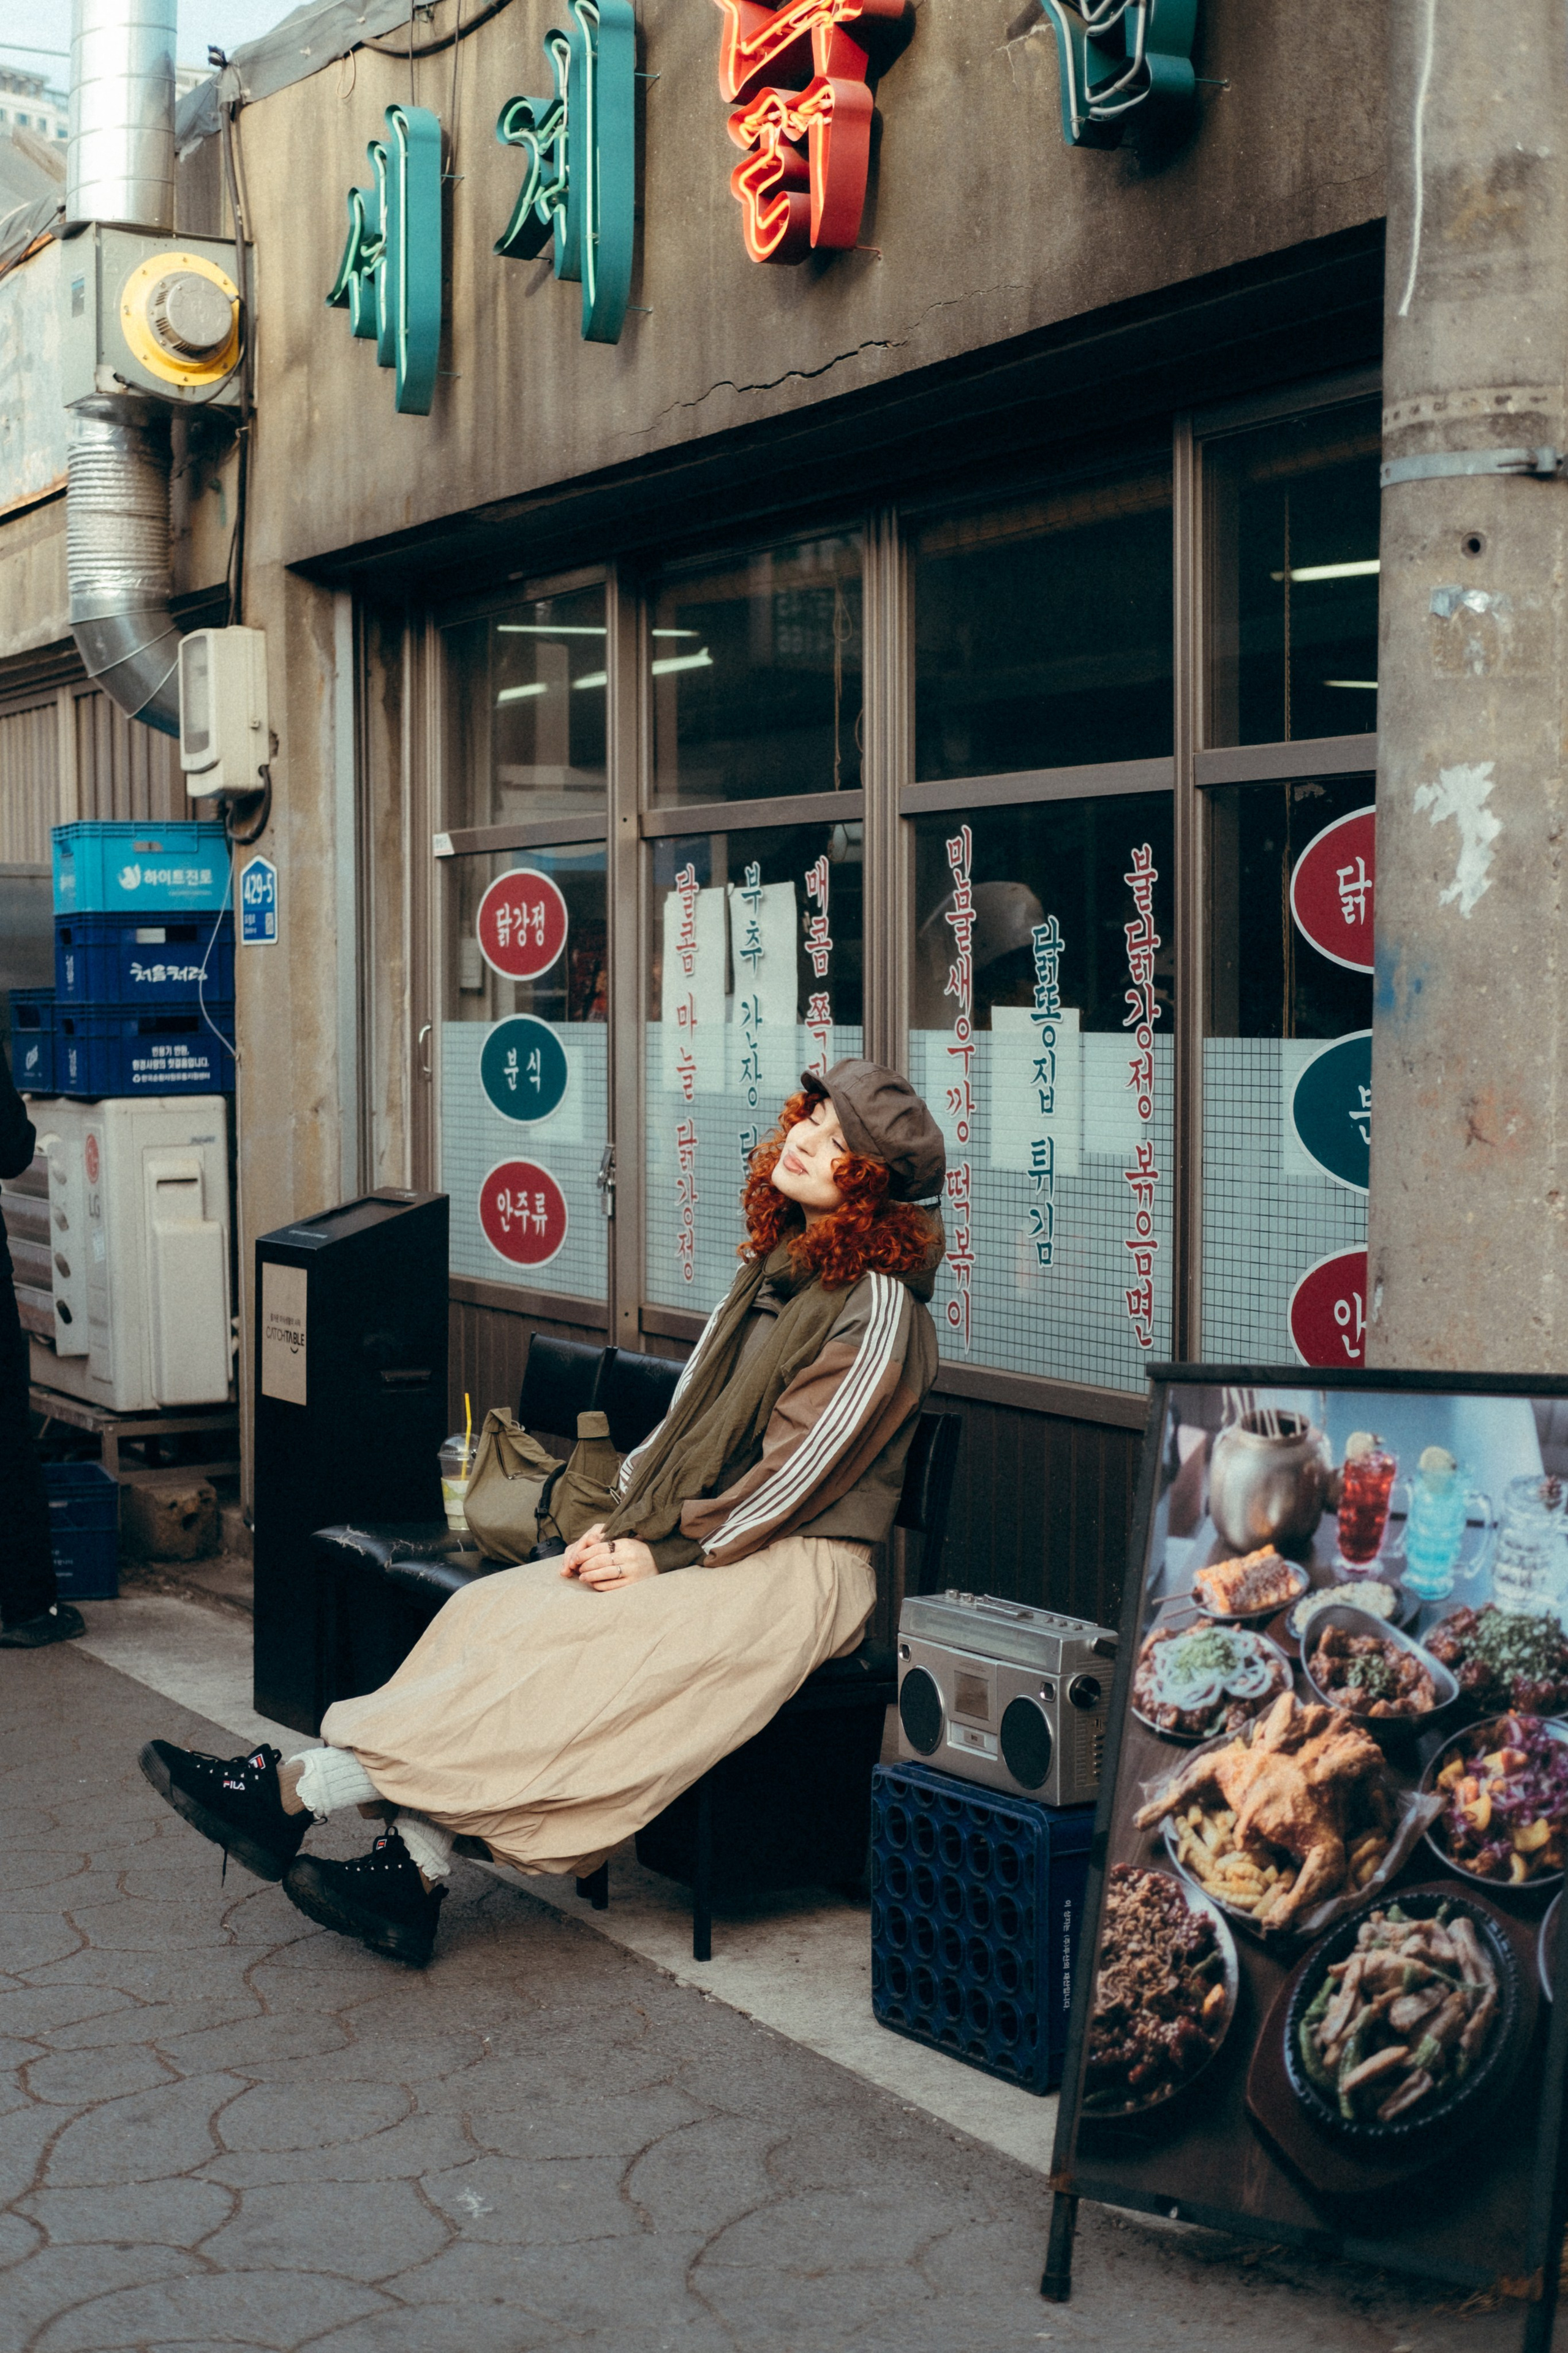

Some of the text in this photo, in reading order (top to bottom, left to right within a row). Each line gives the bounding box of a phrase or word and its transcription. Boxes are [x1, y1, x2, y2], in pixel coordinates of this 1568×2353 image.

[144, 868, 213, 886] 하이트진로
[244, 872, 273, 904] 429-5
[739, 860, 763, 975] 부추
[805, 856, 831, 975] 매콤
[496, 900, 545, 948] 닭강정
[675, 864, 698, 1282] 달콤 마늘 닭강정
[739, 994, 763, 1108] 간장
[945, 826, 976, 1354] 민물새우깡 떡볶이
[1028, 916, 1065, 1267] 닭똥집 튀김
[1124, 844, 1160, 1348] 불닭강정 볶음면
[88, 1193, 101, 1218] LG
[497, 1187, 548, 1237] 안주류
[266, 1326, 304, 1346] CATCHTABLE
[223, 1780, 246, 1791] FILA
